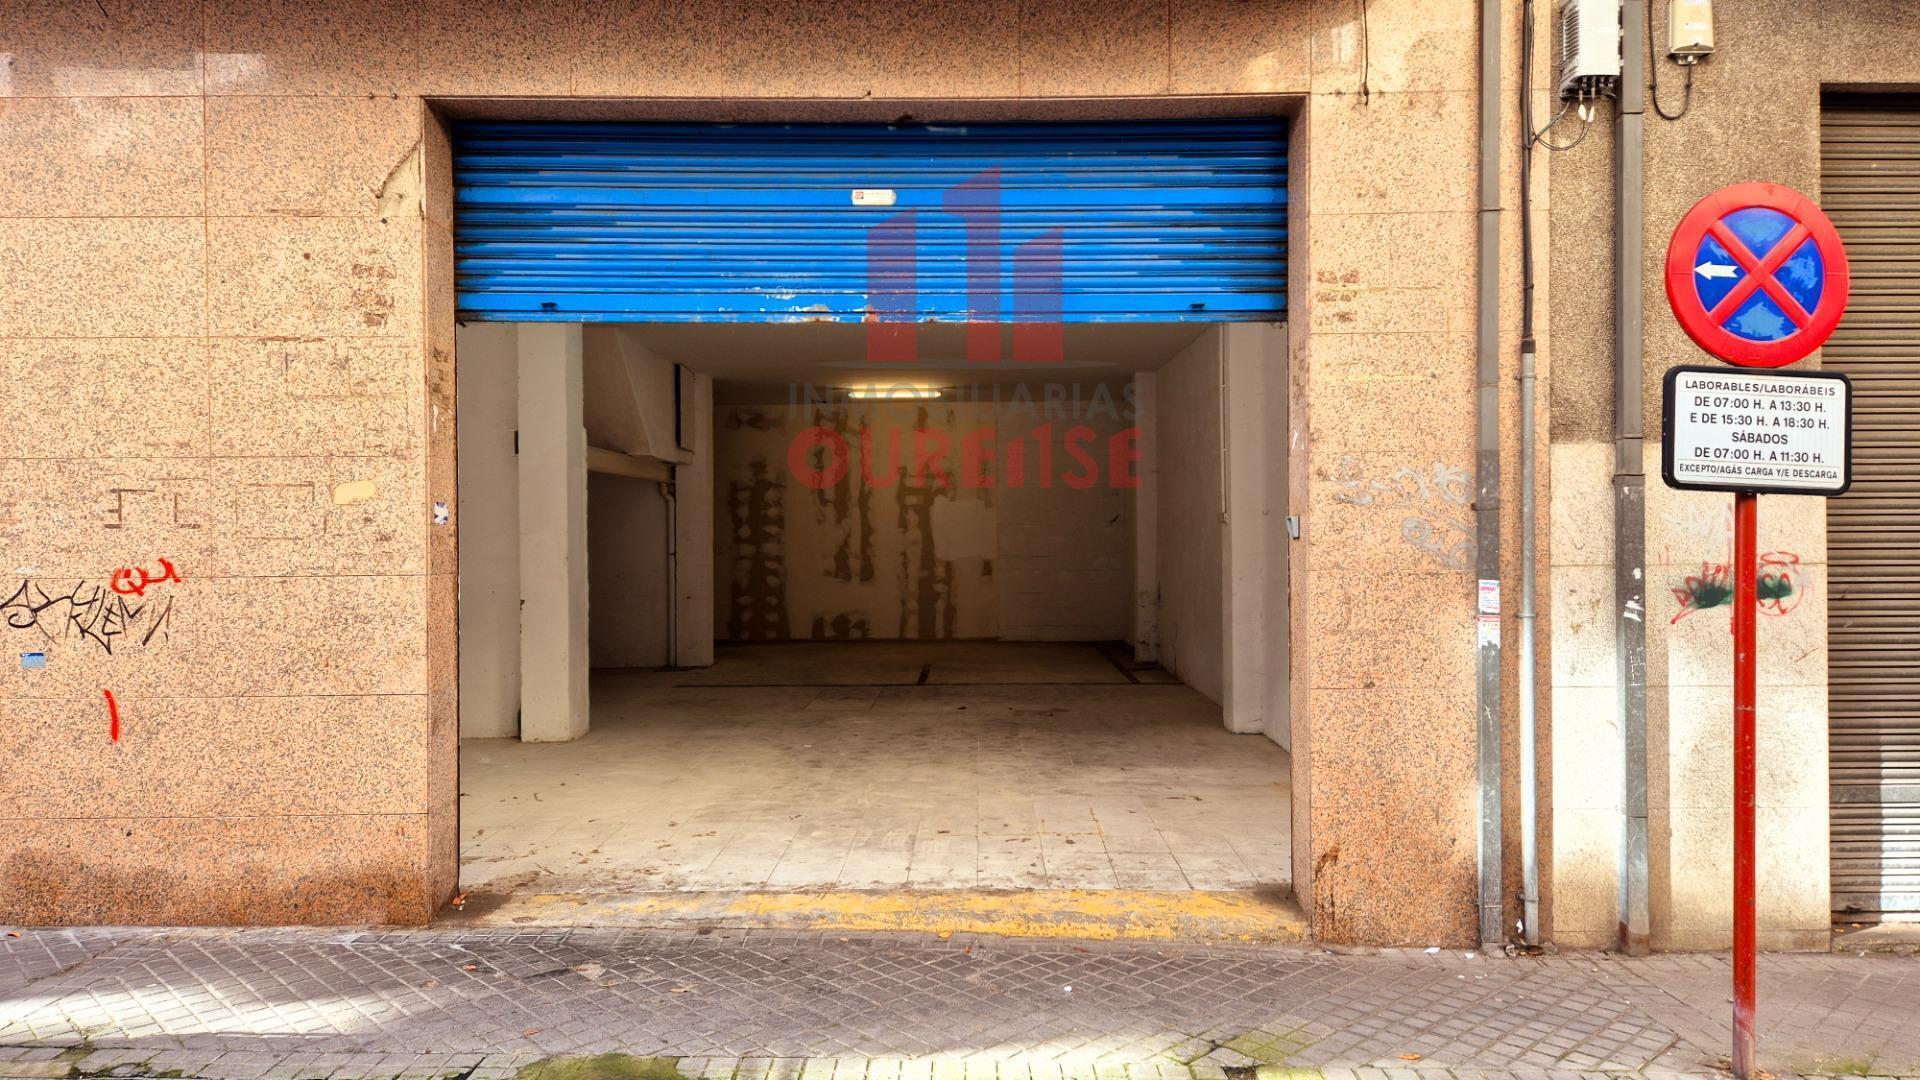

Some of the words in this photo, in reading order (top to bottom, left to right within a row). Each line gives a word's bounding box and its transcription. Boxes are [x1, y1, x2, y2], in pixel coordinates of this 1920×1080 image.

[1685, 380, 1836, 396] LABORABLES/LABORÁBEIS
[1694, 396, 1710, 407] DE
[1714, 397, 1749, 409] 07:00
[1753, 400, 1764, 410] H.
[1769, 401, 1777, 410] A
[1781, 401, 1811, 412] 13:30
[1815, 403, 1827, 413] H.
[1690, 413, 1697, 422] E
[1702, 413, 1717, 424] DE
[1722, 415, 1752, 425] 15:30
[1756, 416, 1768, 426] H.
[1773, 417, 1780, 427] A
[1784, 418, 1814, 428] 18:30
[1818, 419, 1830, 429] H.
[1732, 430, 1788, 444] SÁBADOS
[1694, 447, 1710, 458] DE
[1714, 448, 1749, 460] 07:00
[1753, 450, 1764, 461] H.
[1769, 451, 1777, 461] A
[1781, 452, 1809, 463] 11:30
[1813, 453, 1824, 463] H.
[1680, 464, 1742, 474] EXCEPTO/AGÁS
[1745, 466, 1773, 476] CARGA
[1776, 468, 1790, 477] Y/E
[1793, 469, 1837, 479] DESCARGA
